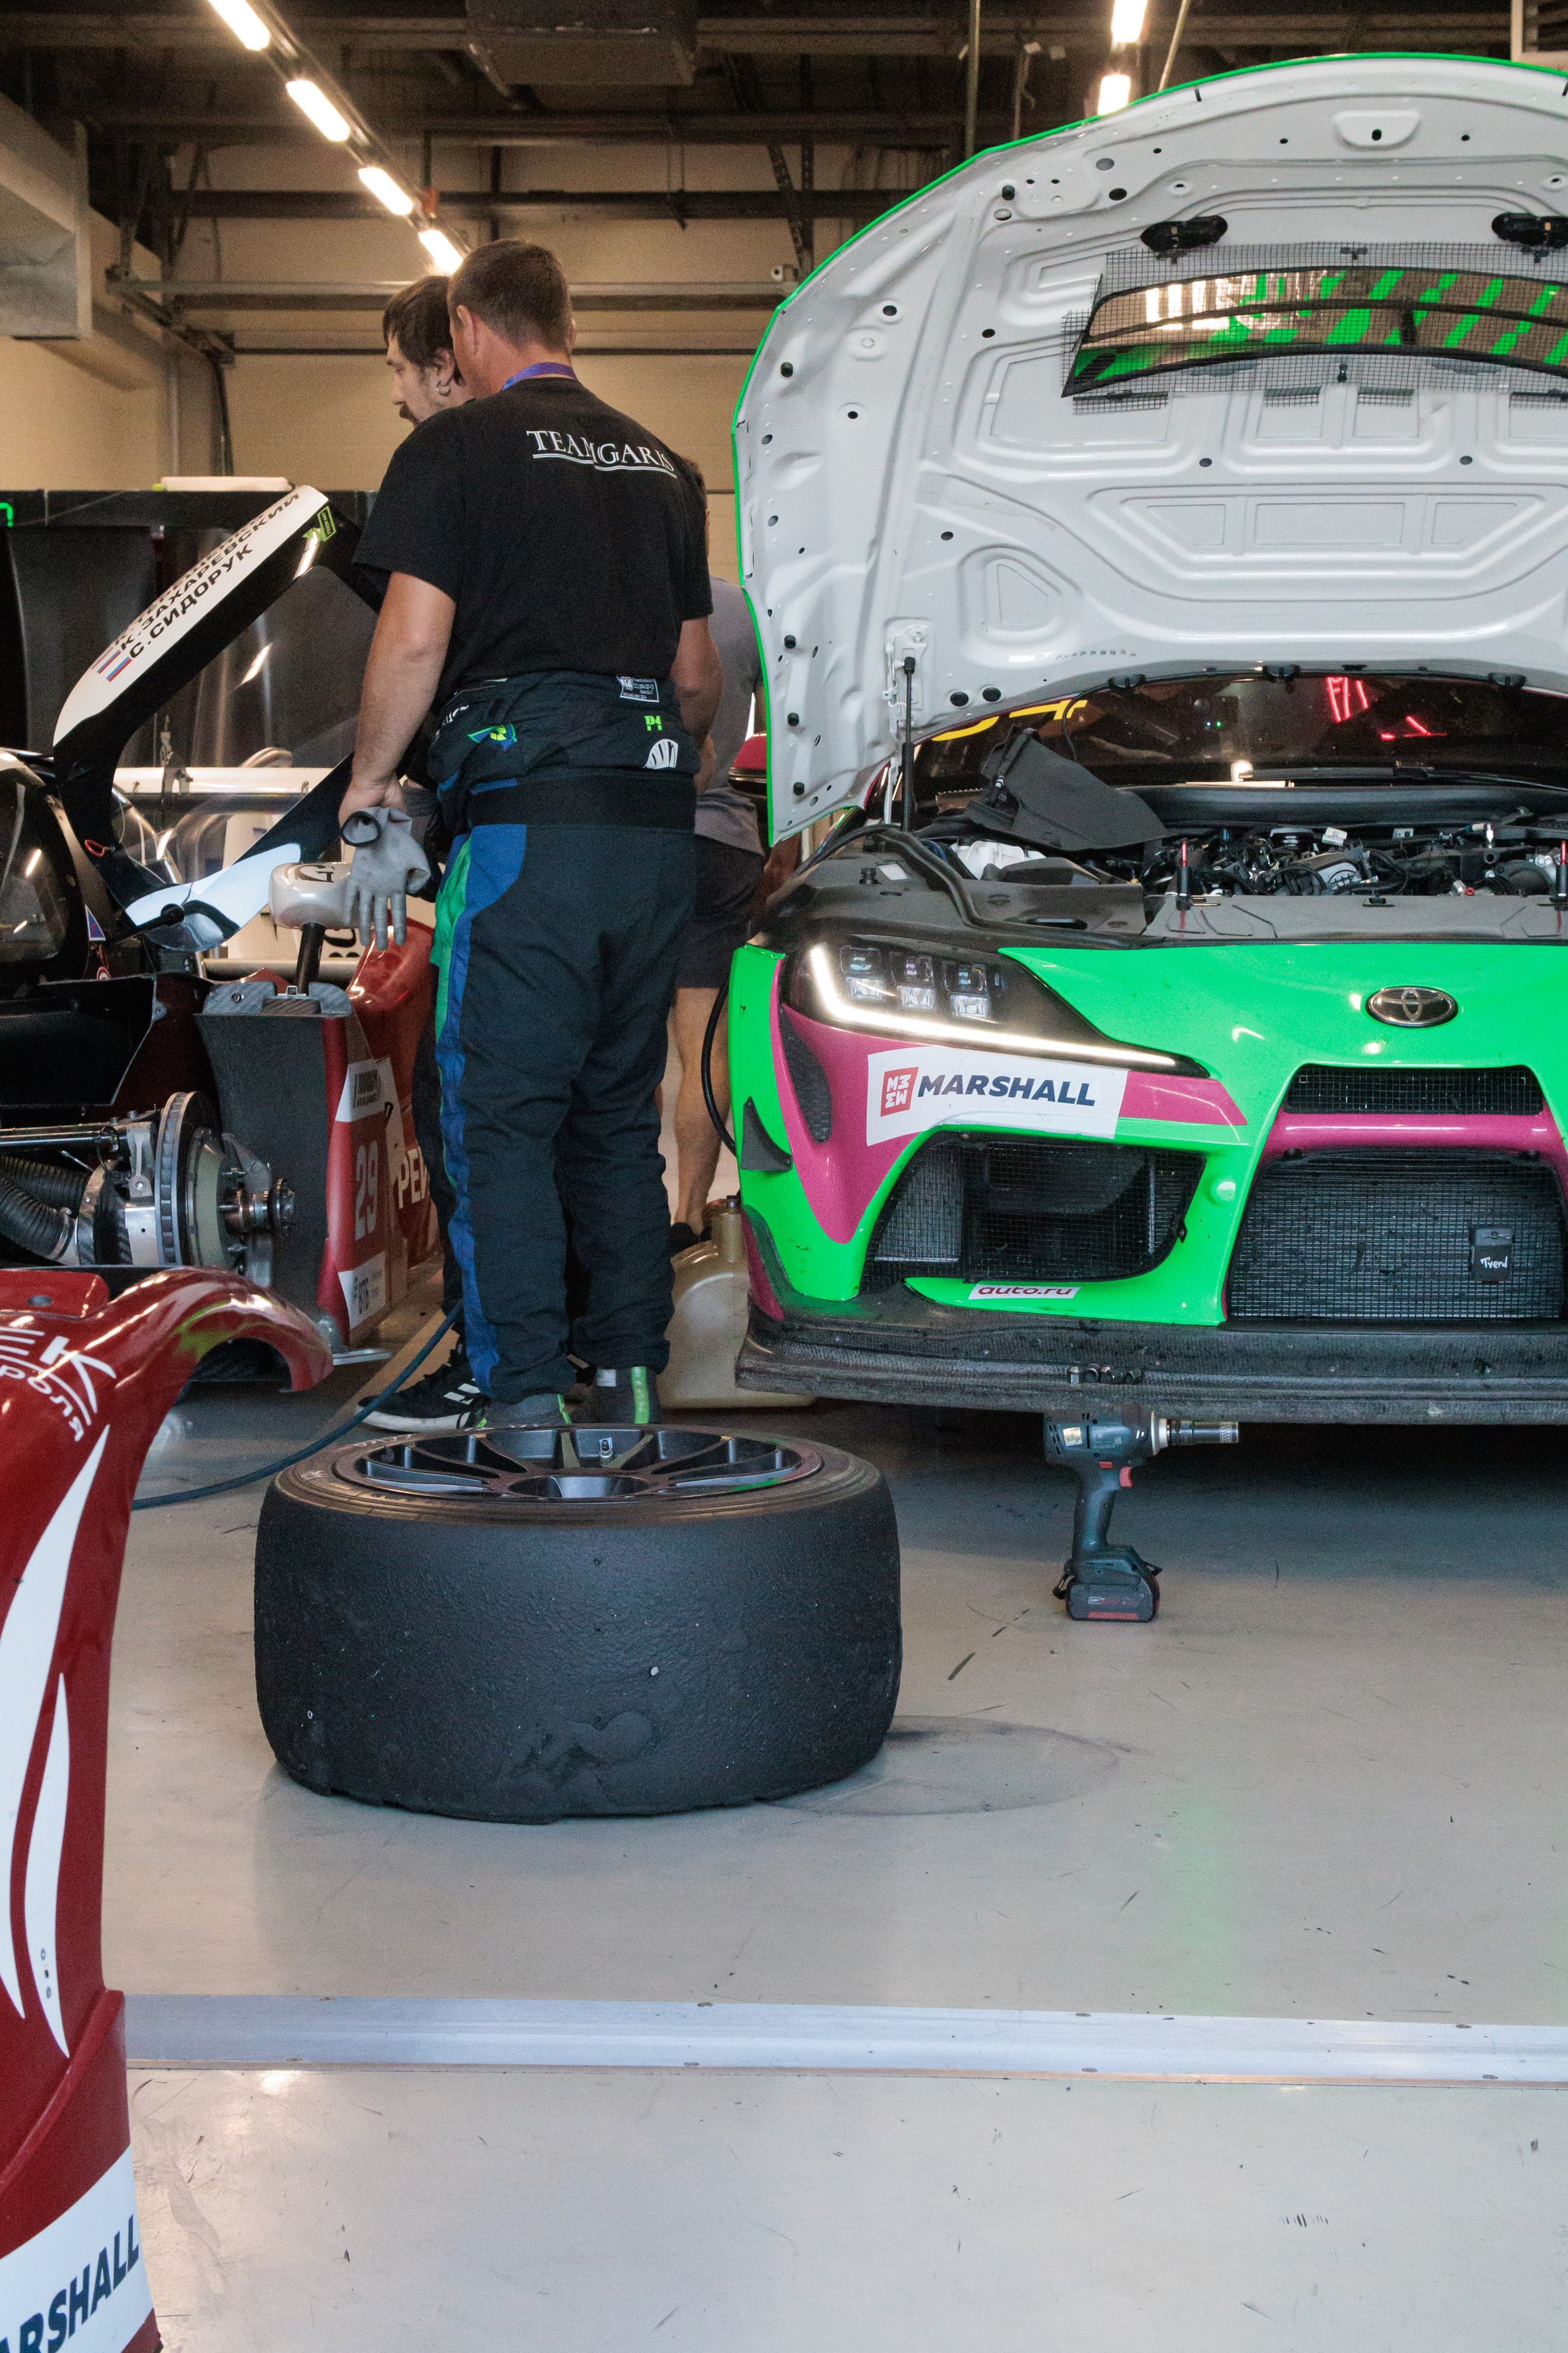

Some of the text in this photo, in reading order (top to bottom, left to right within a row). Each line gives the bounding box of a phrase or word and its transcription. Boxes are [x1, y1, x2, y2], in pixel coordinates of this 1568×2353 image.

[917, 1075, 1096, 1106] MARSHALL
[355, 1141, 378, 1241] 29
[1480, 1256, 1508, 1269] Tverd
[978, 1286, 1072, 1296] auto.ru
[0, 2213, 139, 2353] RSHALL
